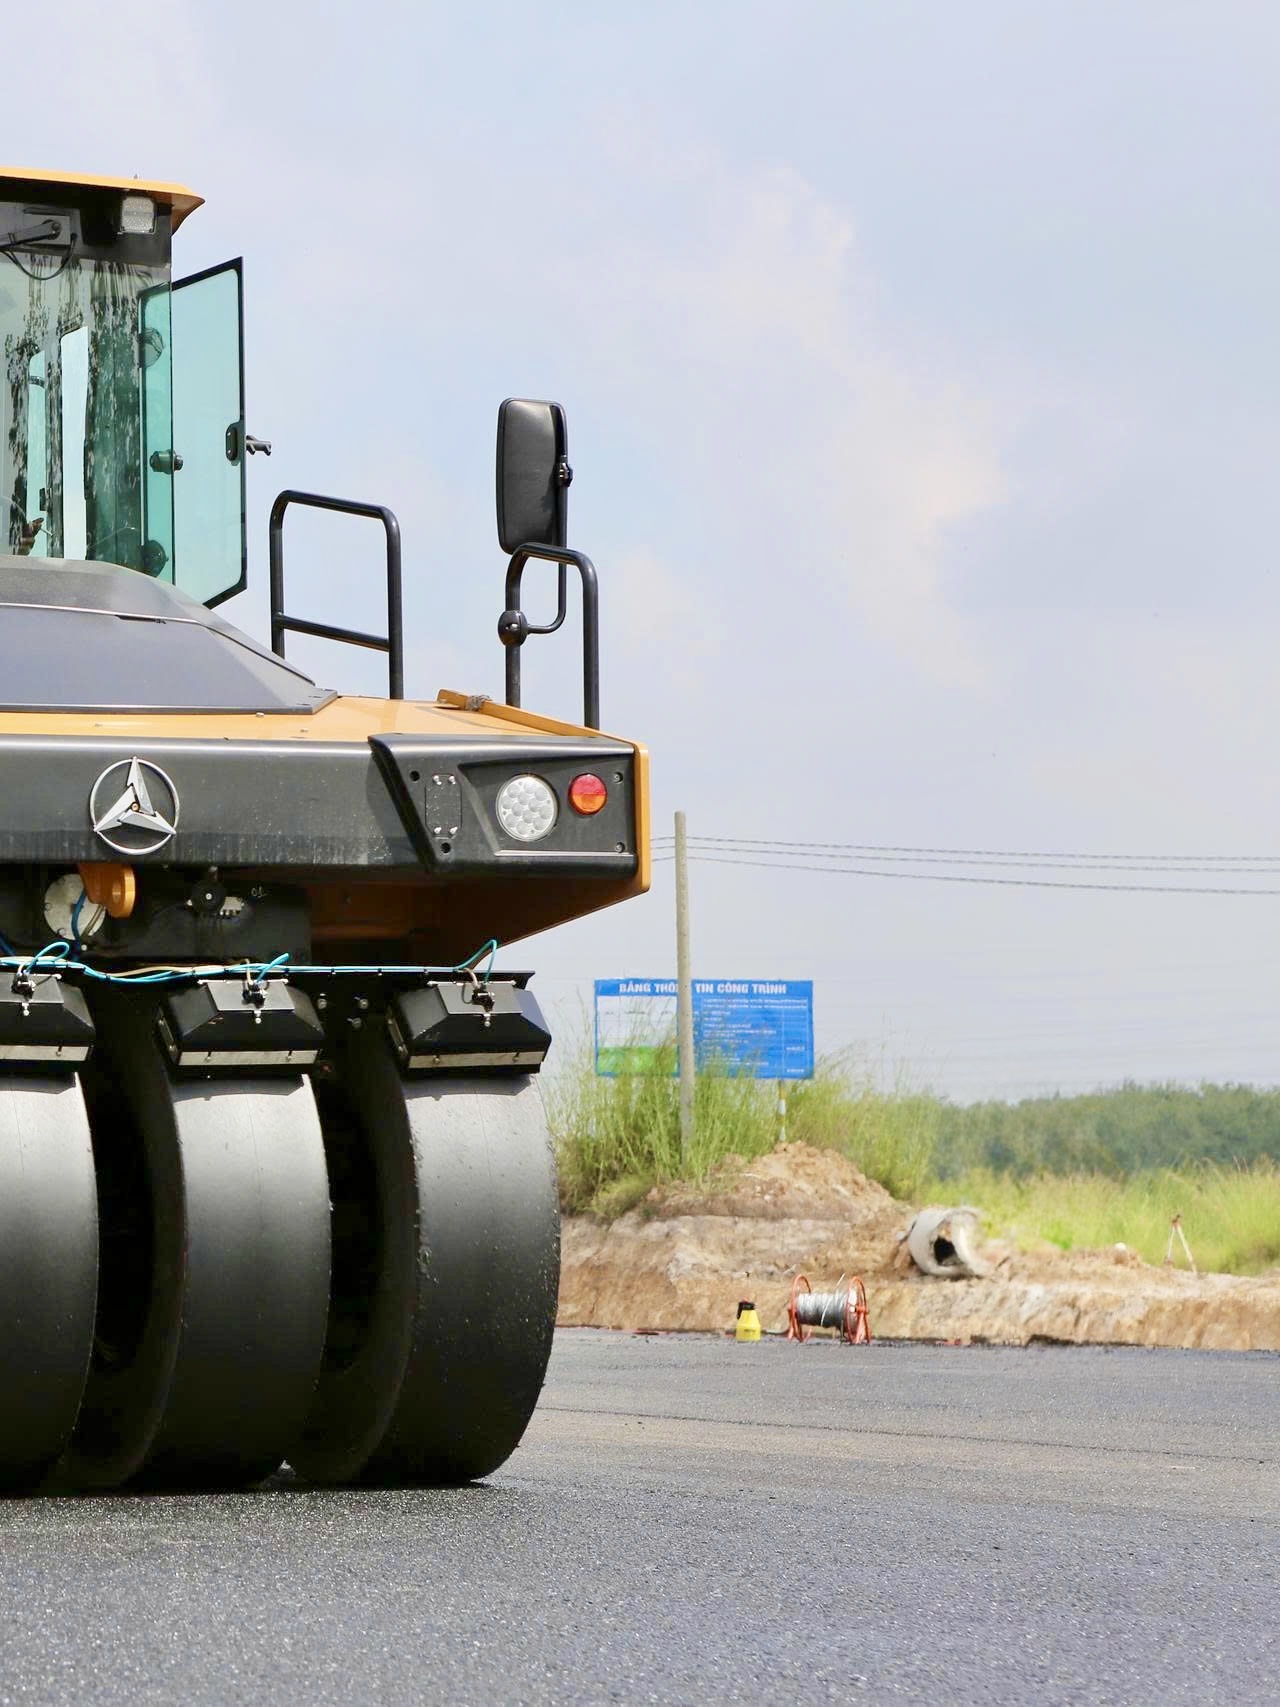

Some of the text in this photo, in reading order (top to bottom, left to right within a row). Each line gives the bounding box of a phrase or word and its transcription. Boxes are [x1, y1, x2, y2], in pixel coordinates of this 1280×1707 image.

[653, 981, 679, 994] THÔ
[695, 981, 714, 994] TIN
[717, 980, 749, 994] CÔNG
[752, 980, 786, 994] TRÌNH
